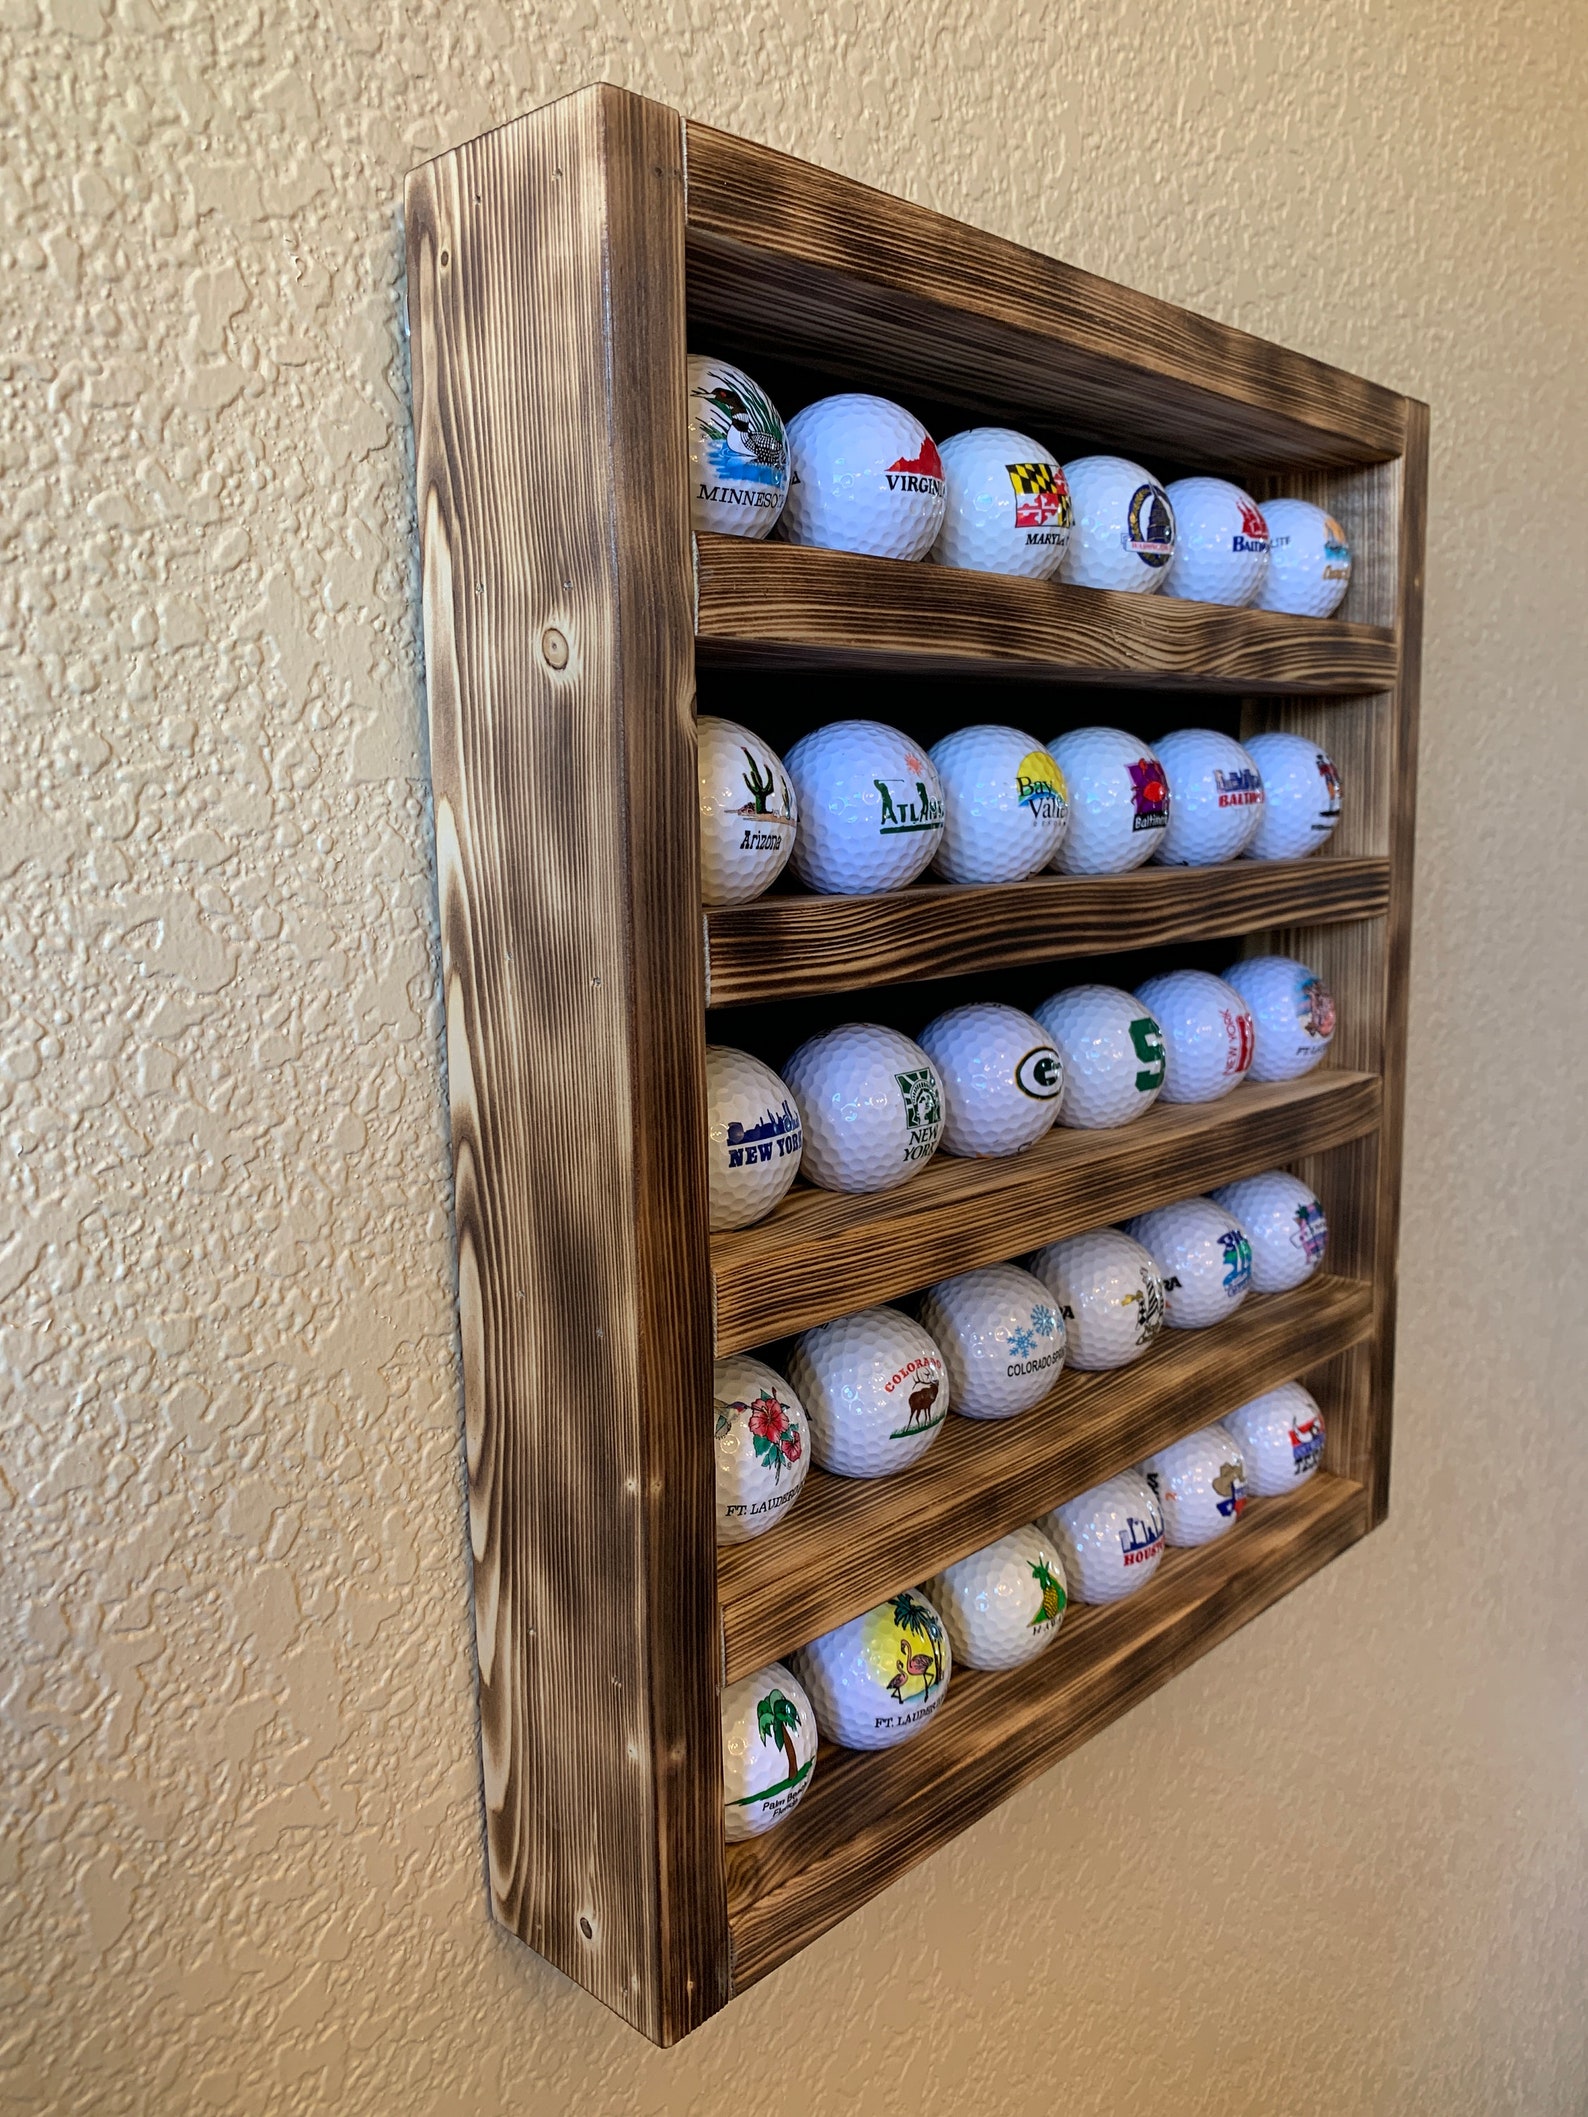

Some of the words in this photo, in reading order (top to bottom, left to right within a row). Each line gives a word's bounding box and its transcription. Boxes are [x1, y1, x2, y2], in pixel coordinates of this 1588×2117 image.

[1015, 776, 1052, 799] Bay
[739, 829, 782, 850] Arizona
[909, 1124, 938, 1146] NEW
[729, 1141, 773, 1168] NEW
[885, 1357, 941, 1393] COLORADO
[1007, 1354, 1052, 1377] COLORADO
[725, 1504, 747, 1517] FT.
[875, 1717, 894, 1728] FT.
[762, 1799, 786, 1812] Palm
